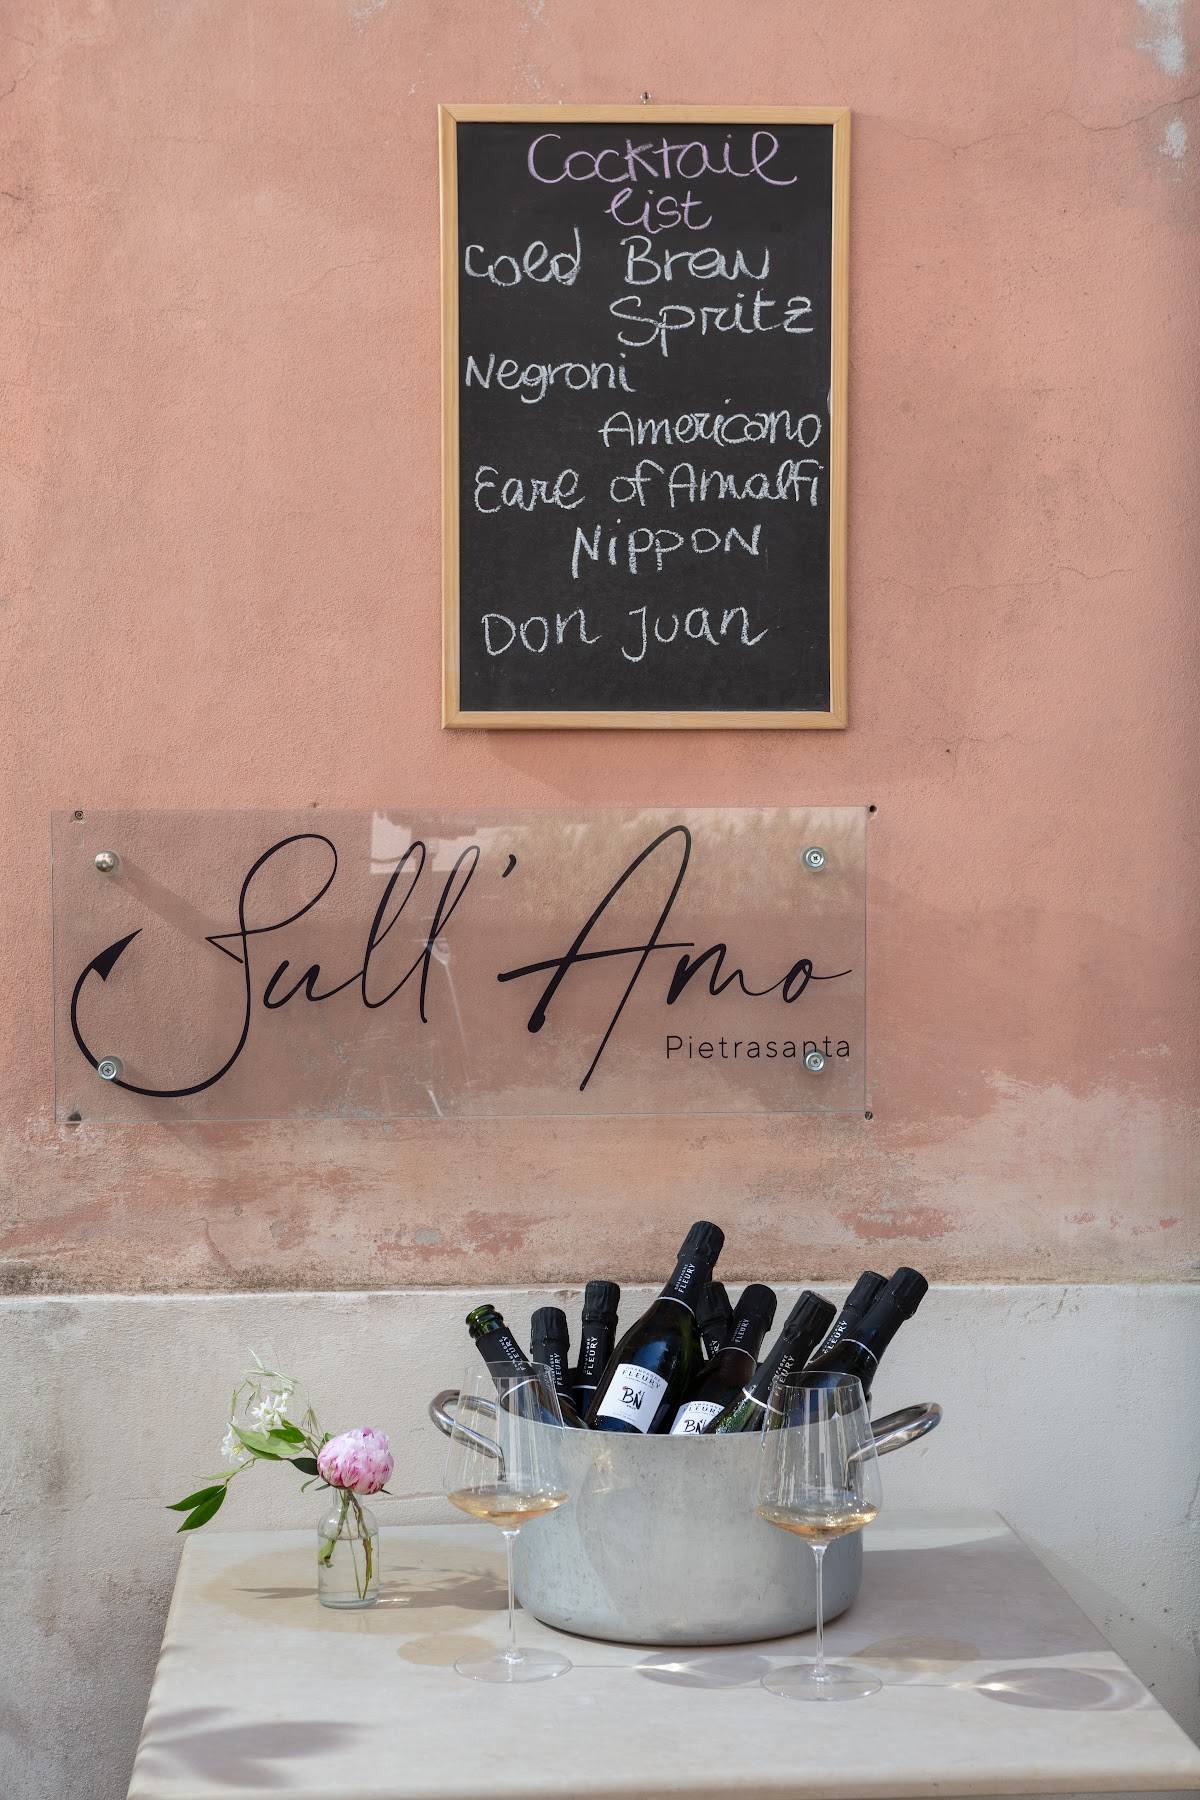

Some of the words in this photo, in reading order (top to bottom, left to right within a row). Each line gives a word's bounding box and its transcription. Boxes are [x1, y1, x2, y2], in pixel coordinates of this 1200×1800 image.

[527, 131, 797, 185] Cocktail
[604, 187, 712, 234] list
[464, 225, 581, 286] Cold
[620, 235, 770, 285] Brew
[609, 288, 814, 357] Spritz
[465, 353, 636, 403] Negroni
[598, 398, 822, 447] Americano
[474, 465, 585, 513] Earl
[610, 459, 664, 507] of
[668, 459, 824, 508] Amalfi
[481, 608, 601, 656] Don
[621, 606, 768, 662] Juan
[678, 1263, 696, 1294] FLEURY
[735, 1318, 749, 1343] FLEURY
[554, 1352, 564, 1386] FLEURY
[587, 1336, 598, 1376] FLEURY
[622, 1369, 661, 1389] FLEURY
